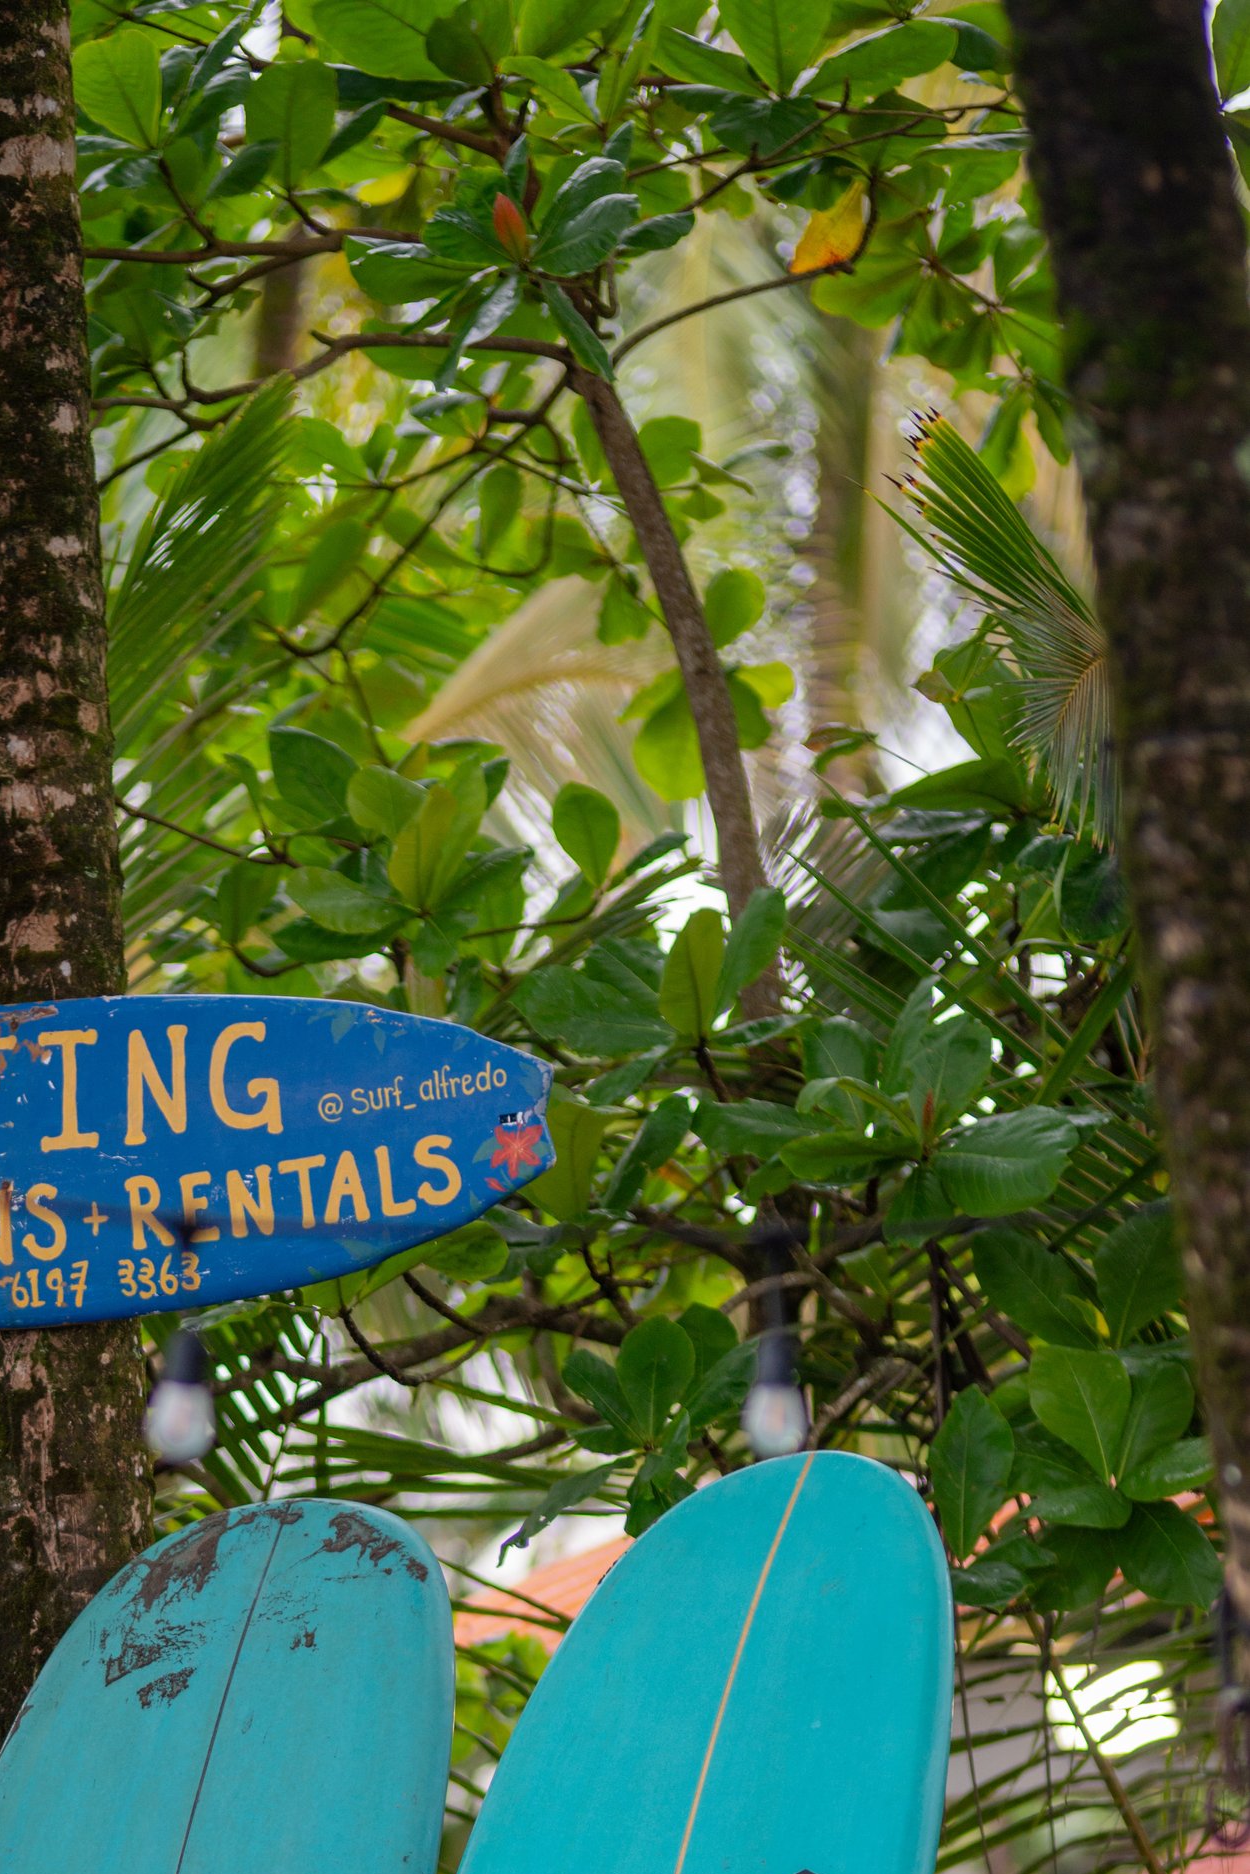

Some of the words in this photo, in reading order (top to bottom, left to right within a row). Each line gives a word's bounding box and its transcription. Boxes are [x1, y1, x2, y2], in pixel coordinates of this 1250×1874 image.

[83, 1201, 109, 1238] +
[123, 1134, 462, 1251] RENTALS
[117, 1251, 201, 1299] 3363
